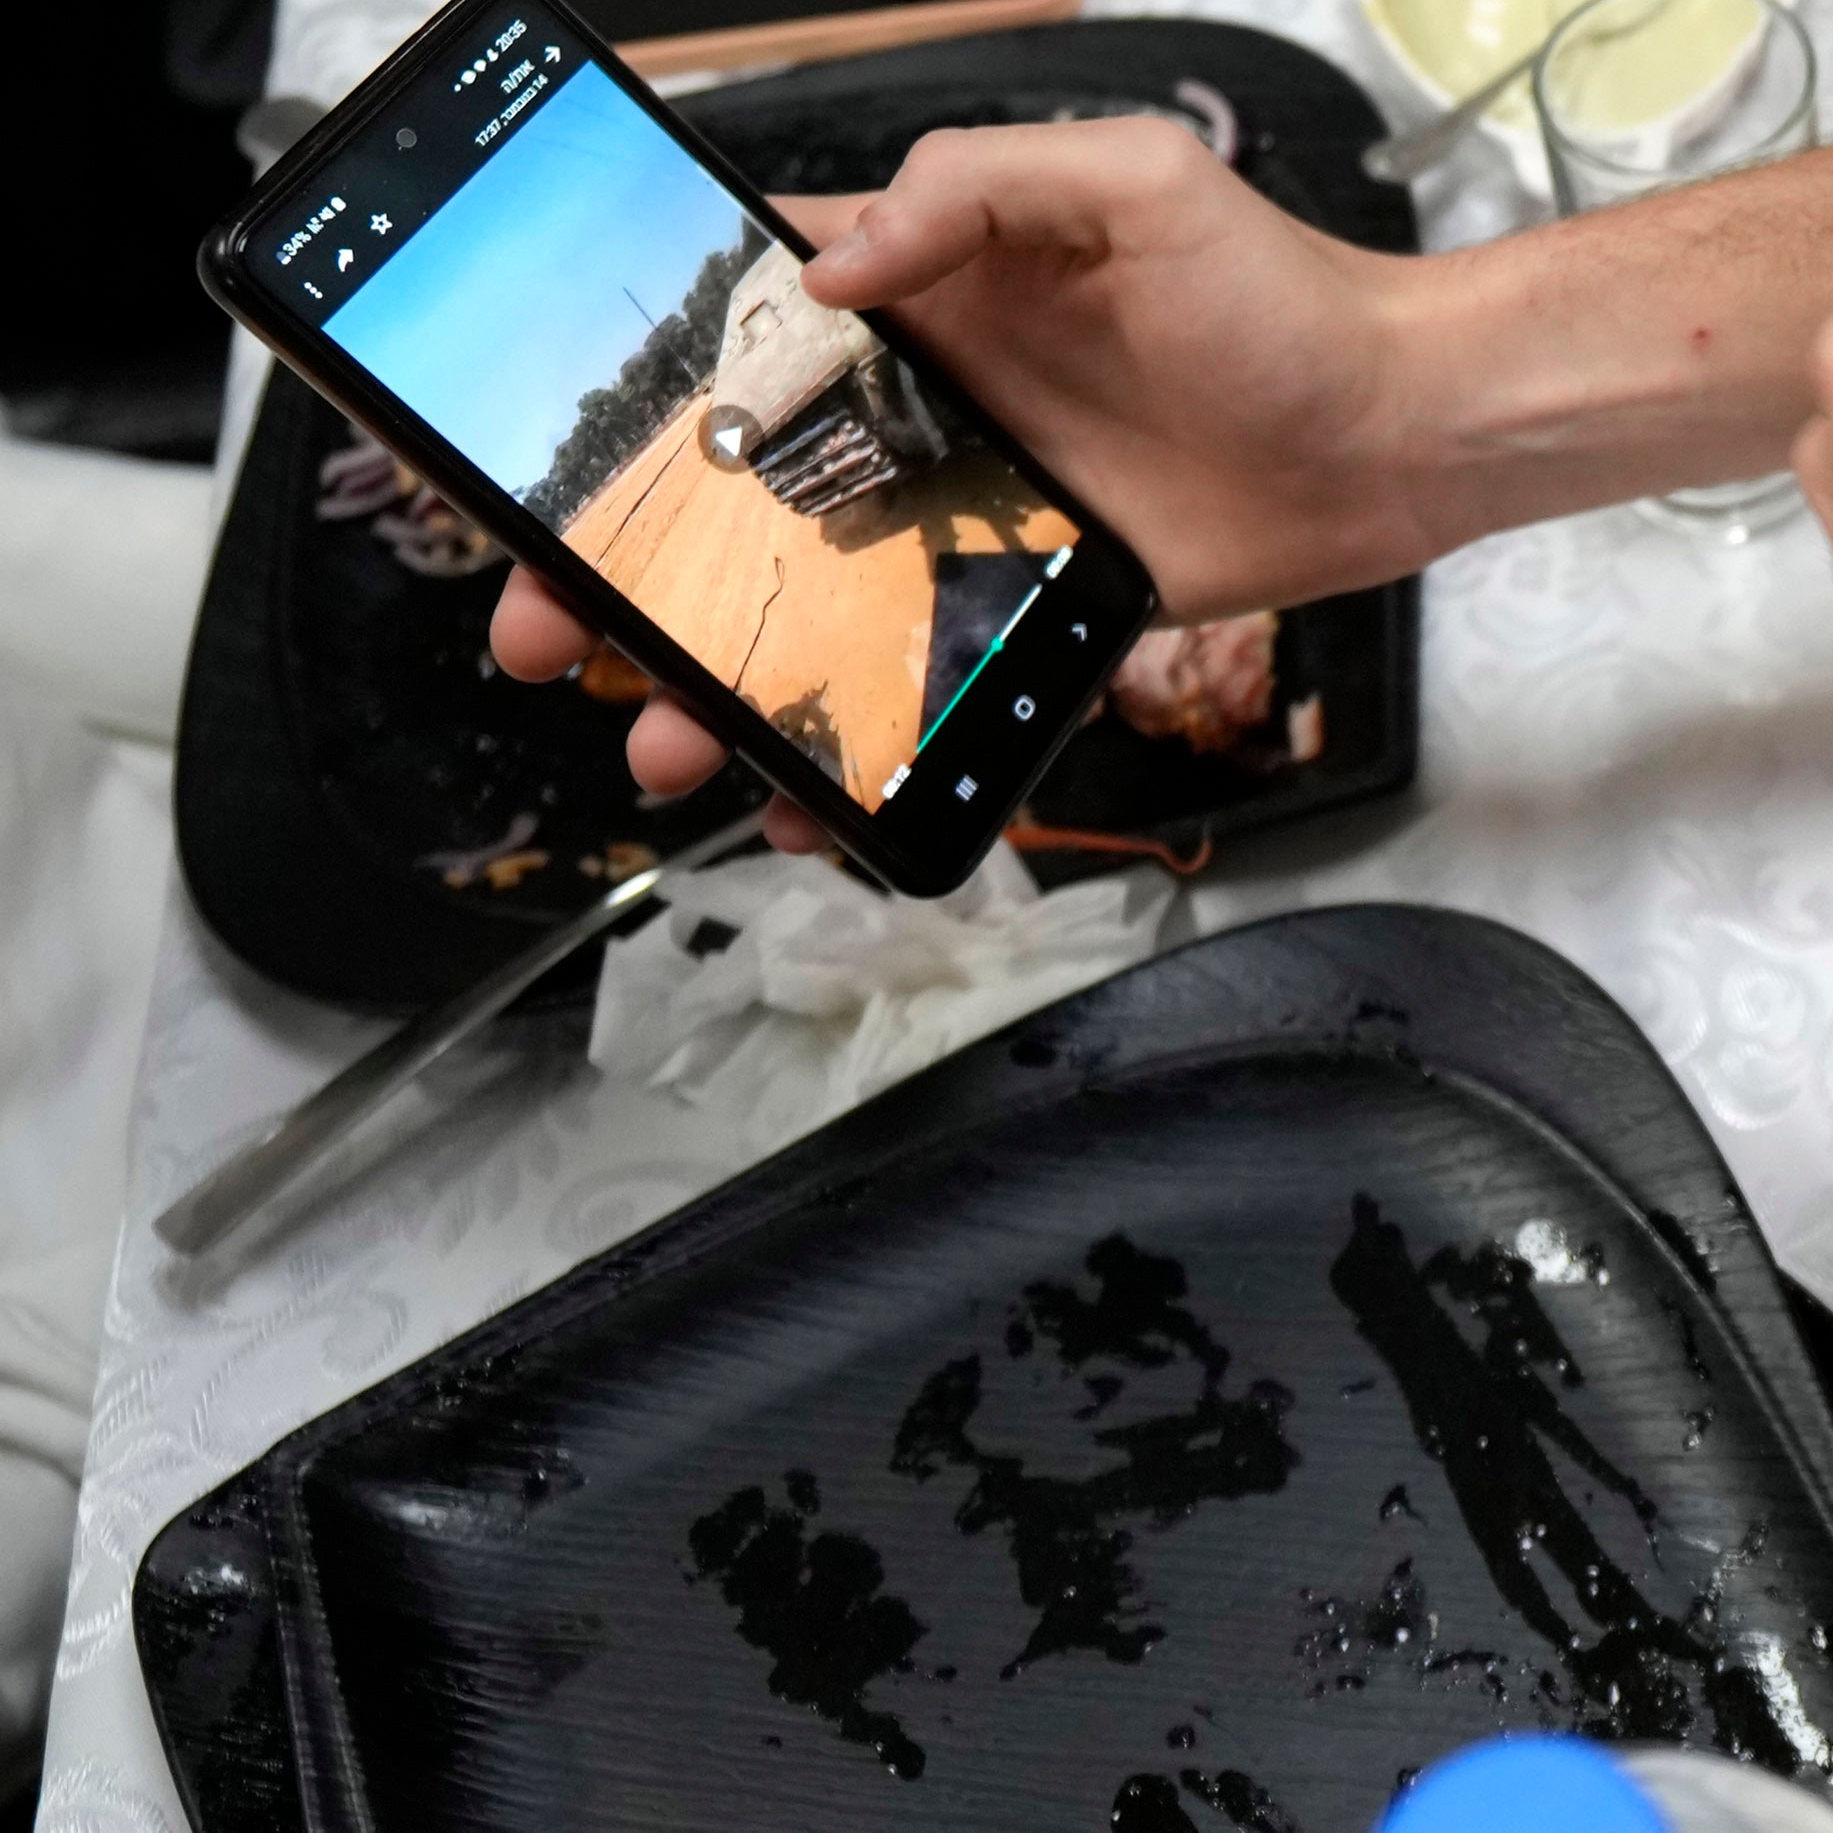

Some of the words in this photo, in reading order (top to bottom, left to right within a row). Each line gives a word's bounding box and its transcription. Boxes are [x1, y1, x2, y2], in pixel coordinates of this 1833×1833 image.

[495, 18, 528, 53] 20:35
[532, 72, 549, 90] 14
[282, 230, 313, 257] 34%
